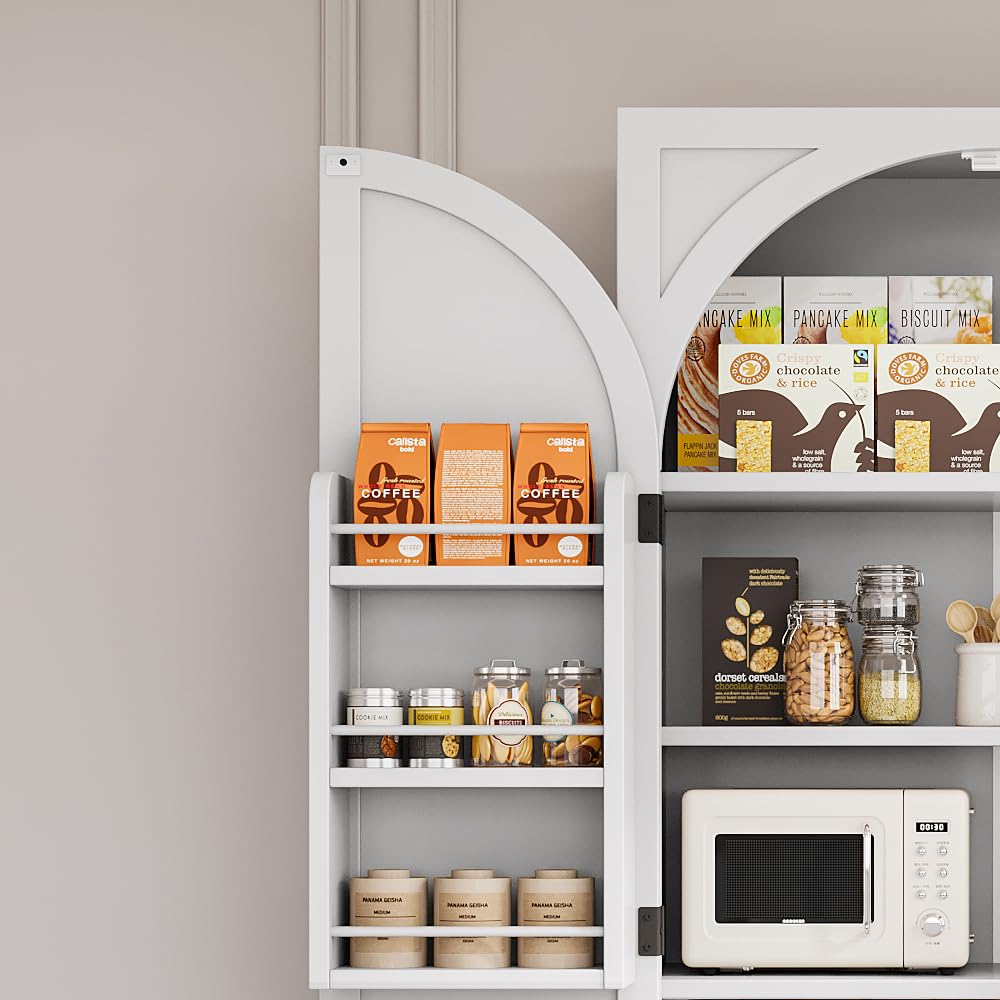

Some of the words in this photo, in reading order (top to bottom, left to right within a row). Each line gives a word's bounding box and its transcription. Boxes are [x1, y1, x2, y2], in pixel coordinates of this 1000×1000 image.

[699, 309, 743, 328] NCAKE
[750, 309, 771, 328] MIX
[793, 309, 849, 328] PANCAKE
[856, 309, 877, 328] MIX
[901, 309, 952, 328] BISCUIT
[958, 309, 980, 328] MIX
[732, 355, 749, 374] DOVES
[750, 353, 769, 365] FARM
[776, 352, 821, 365] Crispy
[891, 355, 908, 374] DOVES
[908, 353, 927, 365] FARM
[935, 352, 979, 365] Crispy
[736, 368, 768, 384] ORGANIC
[776, 365, 841, 376] chocolate
[894, 368, 927, 384] ORGANIC
[935, 365, 999, 376] chocolate
[776, 377, 787, 388] &
[791, 377, 818, 388] rice
[935, 377, 946, 388] &
[950, 377, 976, 388] rice
[802, 448, 814, 456] low
[961, 448, 972, 456] low
[791, 455, 824, 463] wholegrain
[950, 455, 982, 463] wholegrain
[361, 488, 421, 499] COFFEE
[520, 488, 581, 499] COFFEE
[714, 672, 747, 683] dorset
[748, 672, 787, 683] cereals
[919, 823, 945, 831] 00:30
